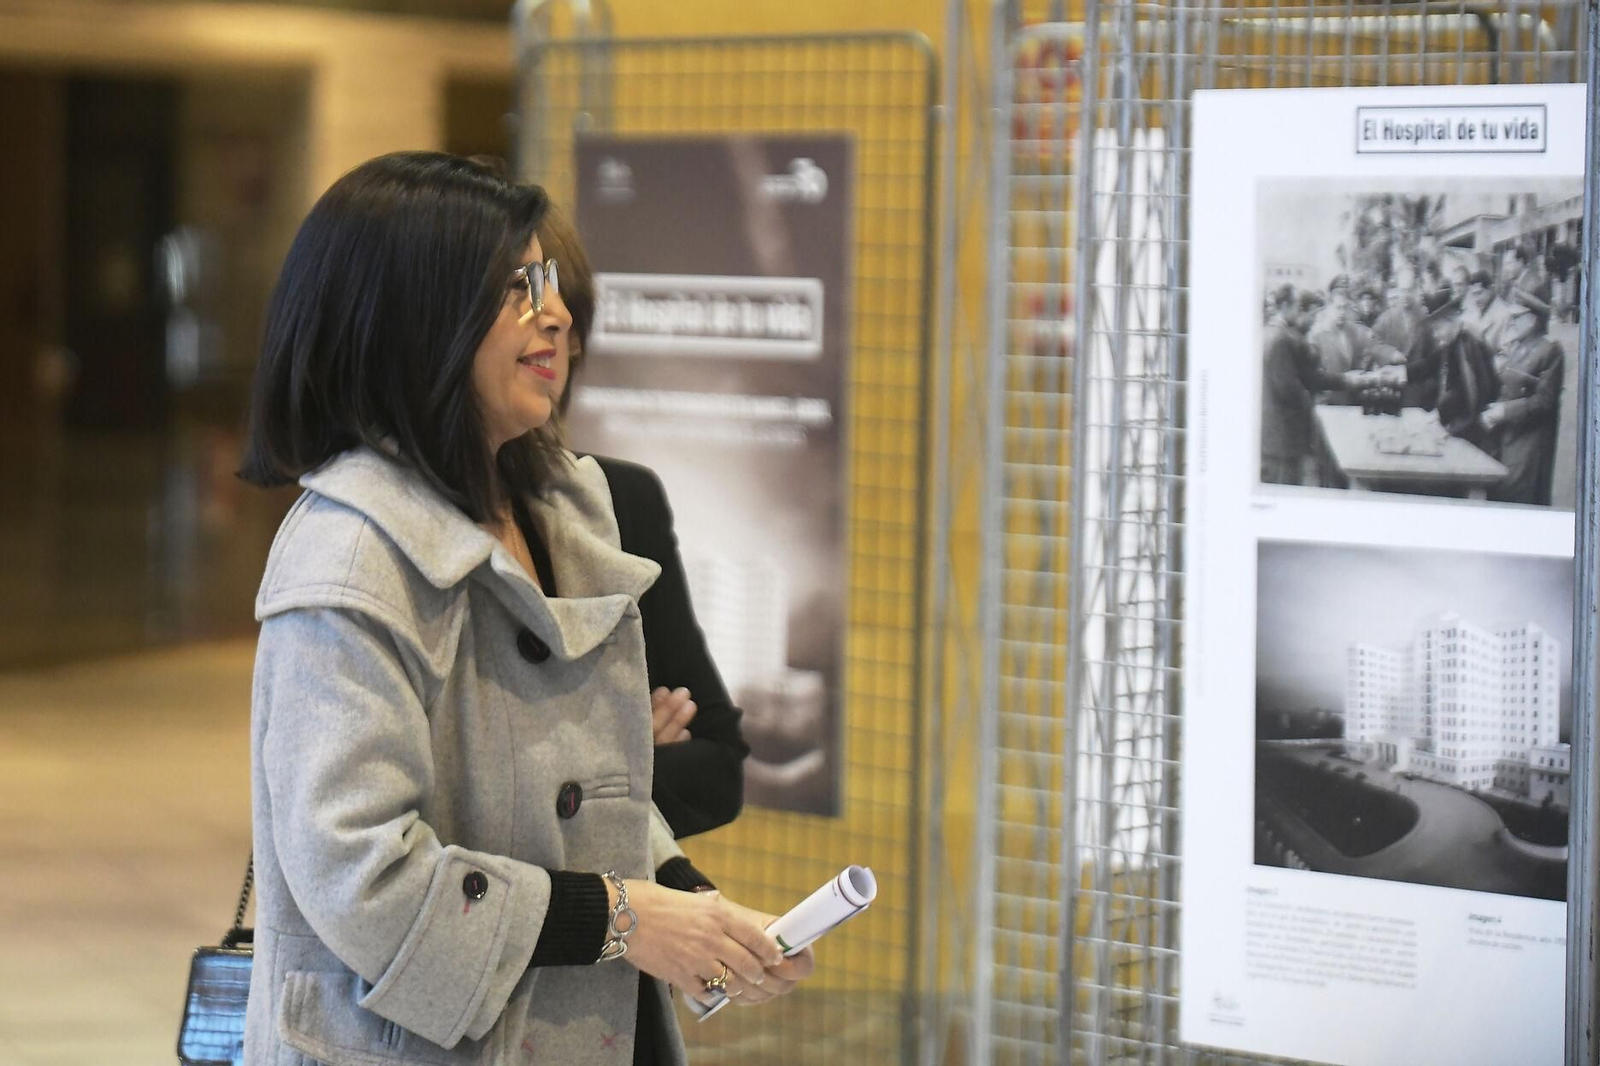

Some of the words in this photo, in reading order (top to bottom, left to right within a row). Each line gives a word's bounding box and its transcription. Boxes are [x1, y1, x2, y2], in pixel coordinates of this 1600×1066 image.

[1363, 119, 1377, 140] El
[1383, 117, 1451, 145] Hospital
[1457, 117, 1476, 140] de
[1482, 118, 1498, 139] tu
[1503, 116, 1539, 139] vida
